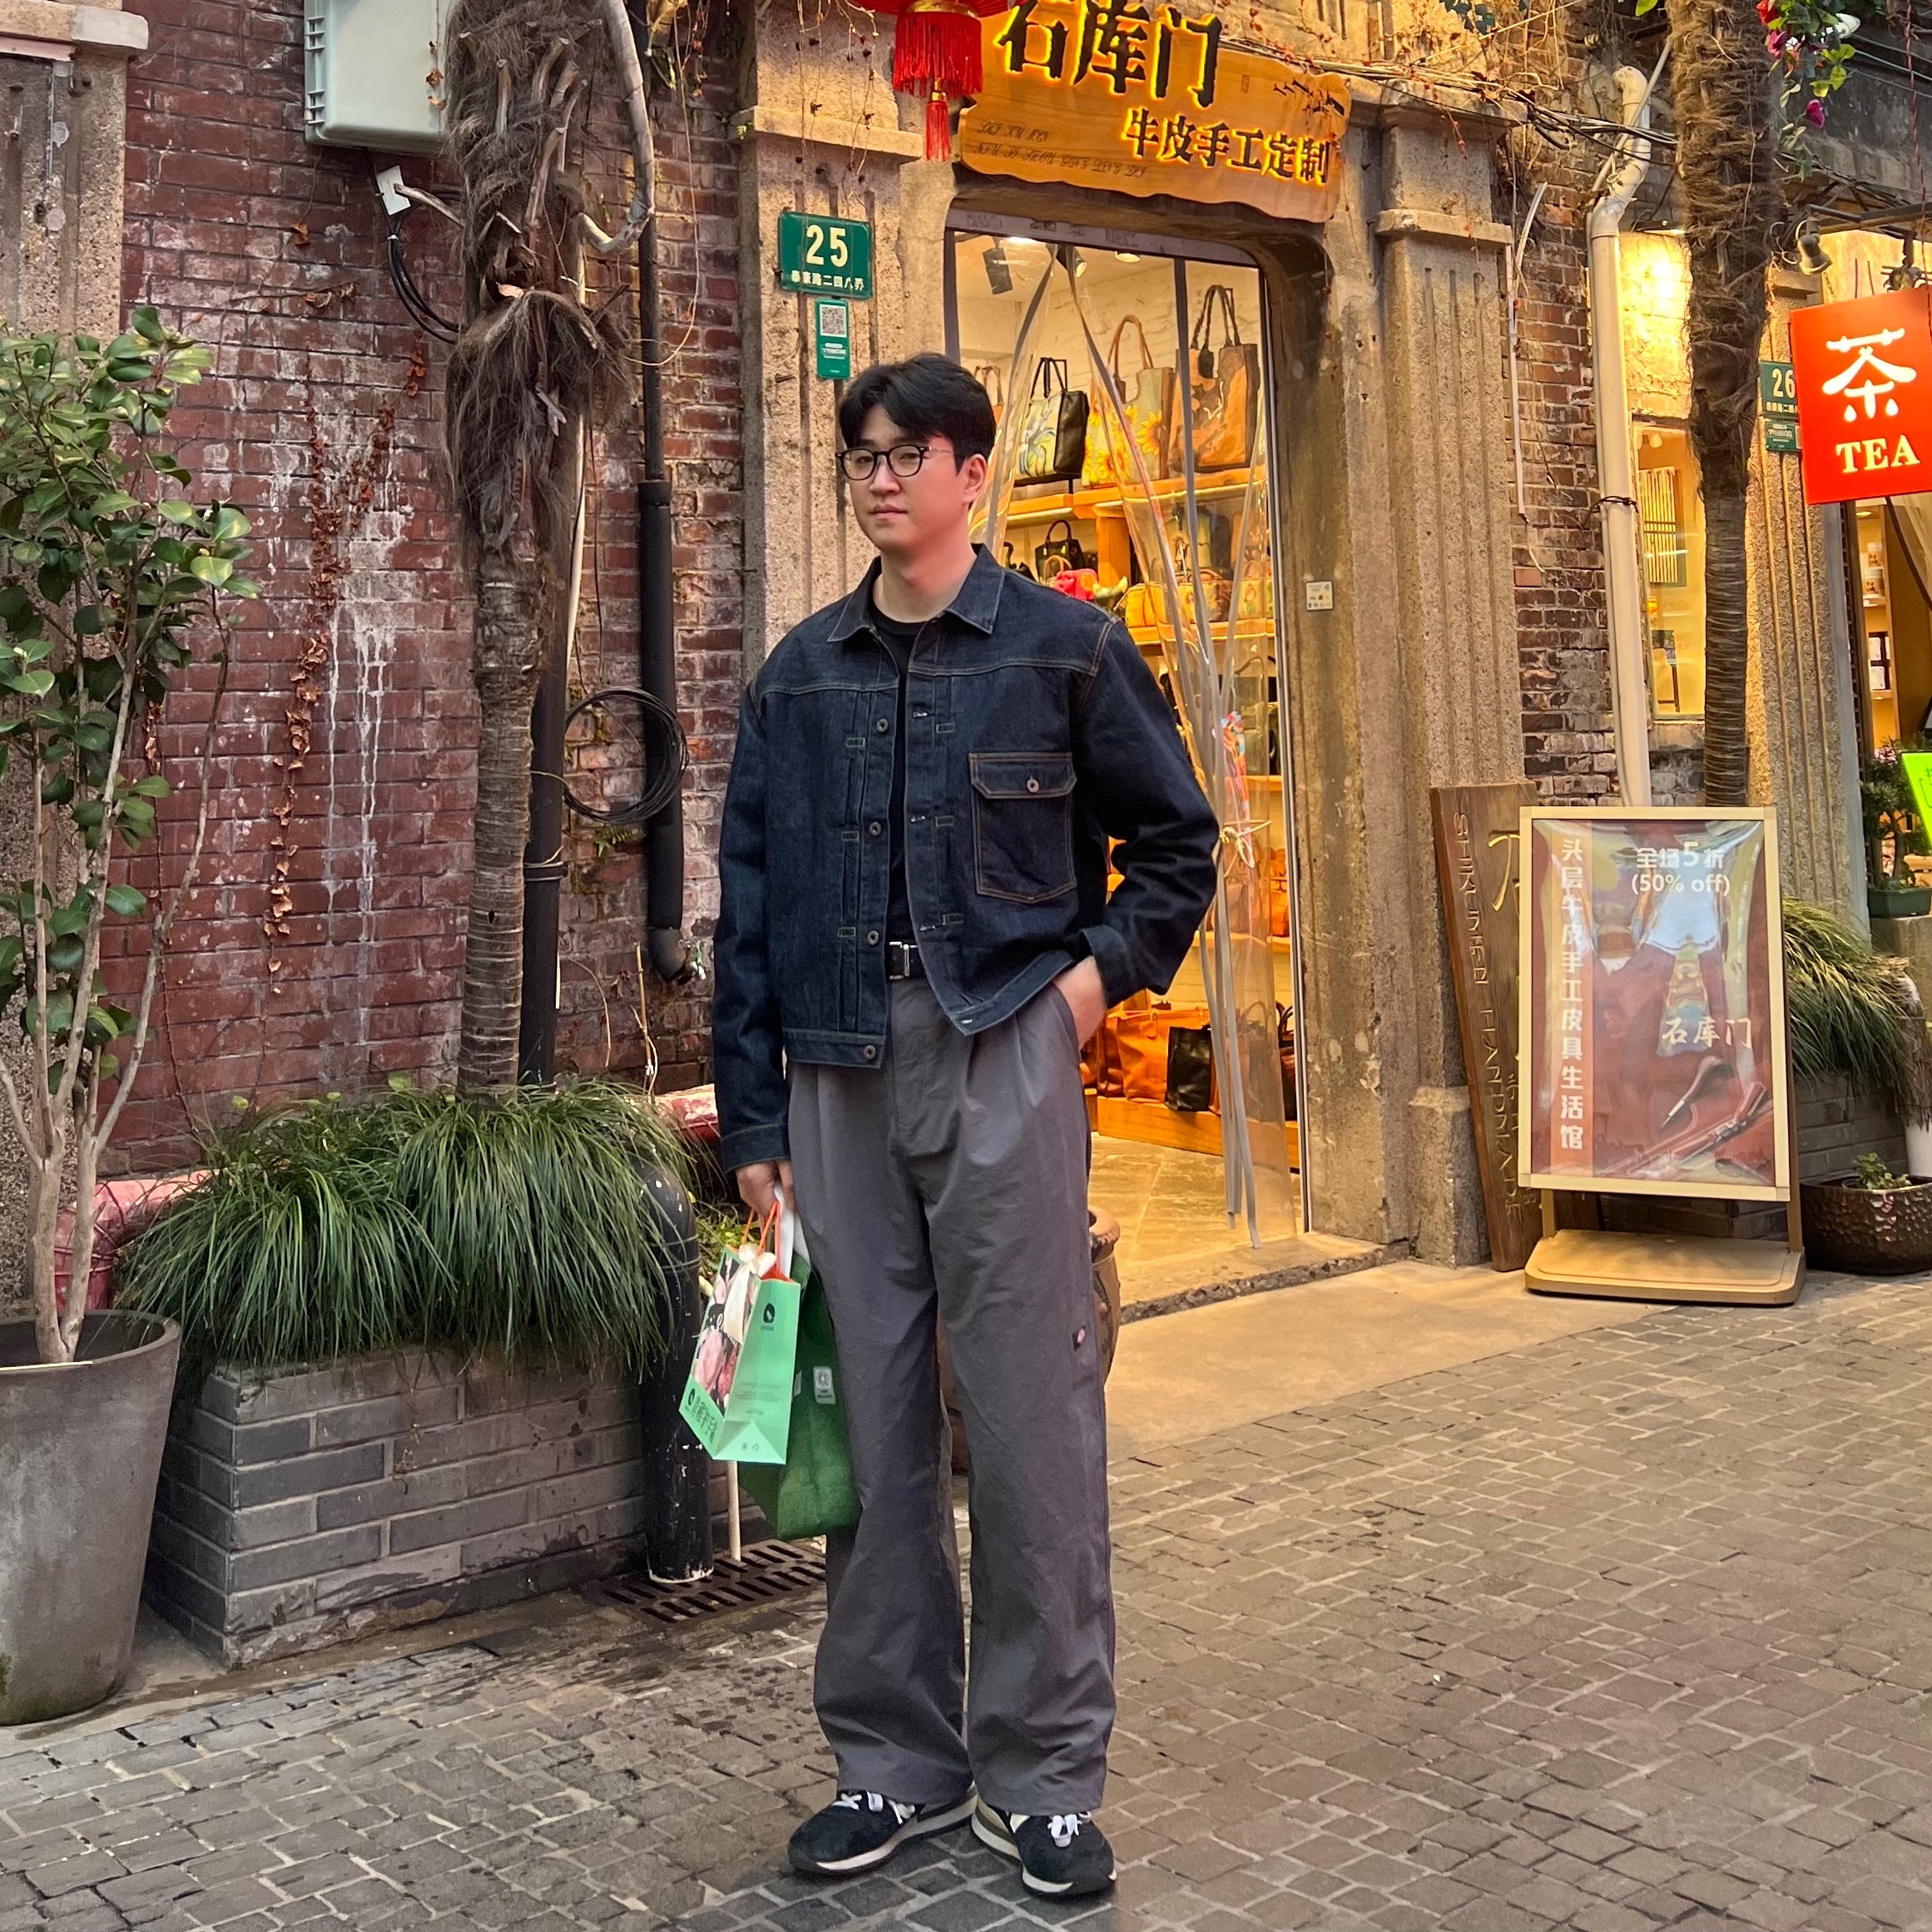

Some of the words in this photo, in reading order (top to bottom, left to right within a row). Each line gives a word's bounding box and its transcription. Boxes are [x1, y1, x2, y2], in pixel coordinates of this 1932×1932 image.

[993, 0, 1223, 108] 石库门
[1122, 107, 1333, 185] 牛皮手工定制
[805, 224, 849, 268] 25
[1771, 368, 1796, 399] 26
[1821, 327, 1917, 422] 茶
[1835, 434, 1920, 473] TEA
[1635, 840, 1725, 869] 全场5折
[1631, 874, 1686, 894] (50%
[1691, 874, 1731, 897] off)
[1559, 837, 1584, 1151] 头层牛皮手工皮具生活馆
[1452, 811, 1489, 985] SHIKUMEN
[1478, 1008, 1523, 1225] HANDMADE
[1661, 1016, 1752, 1050] 石库门
